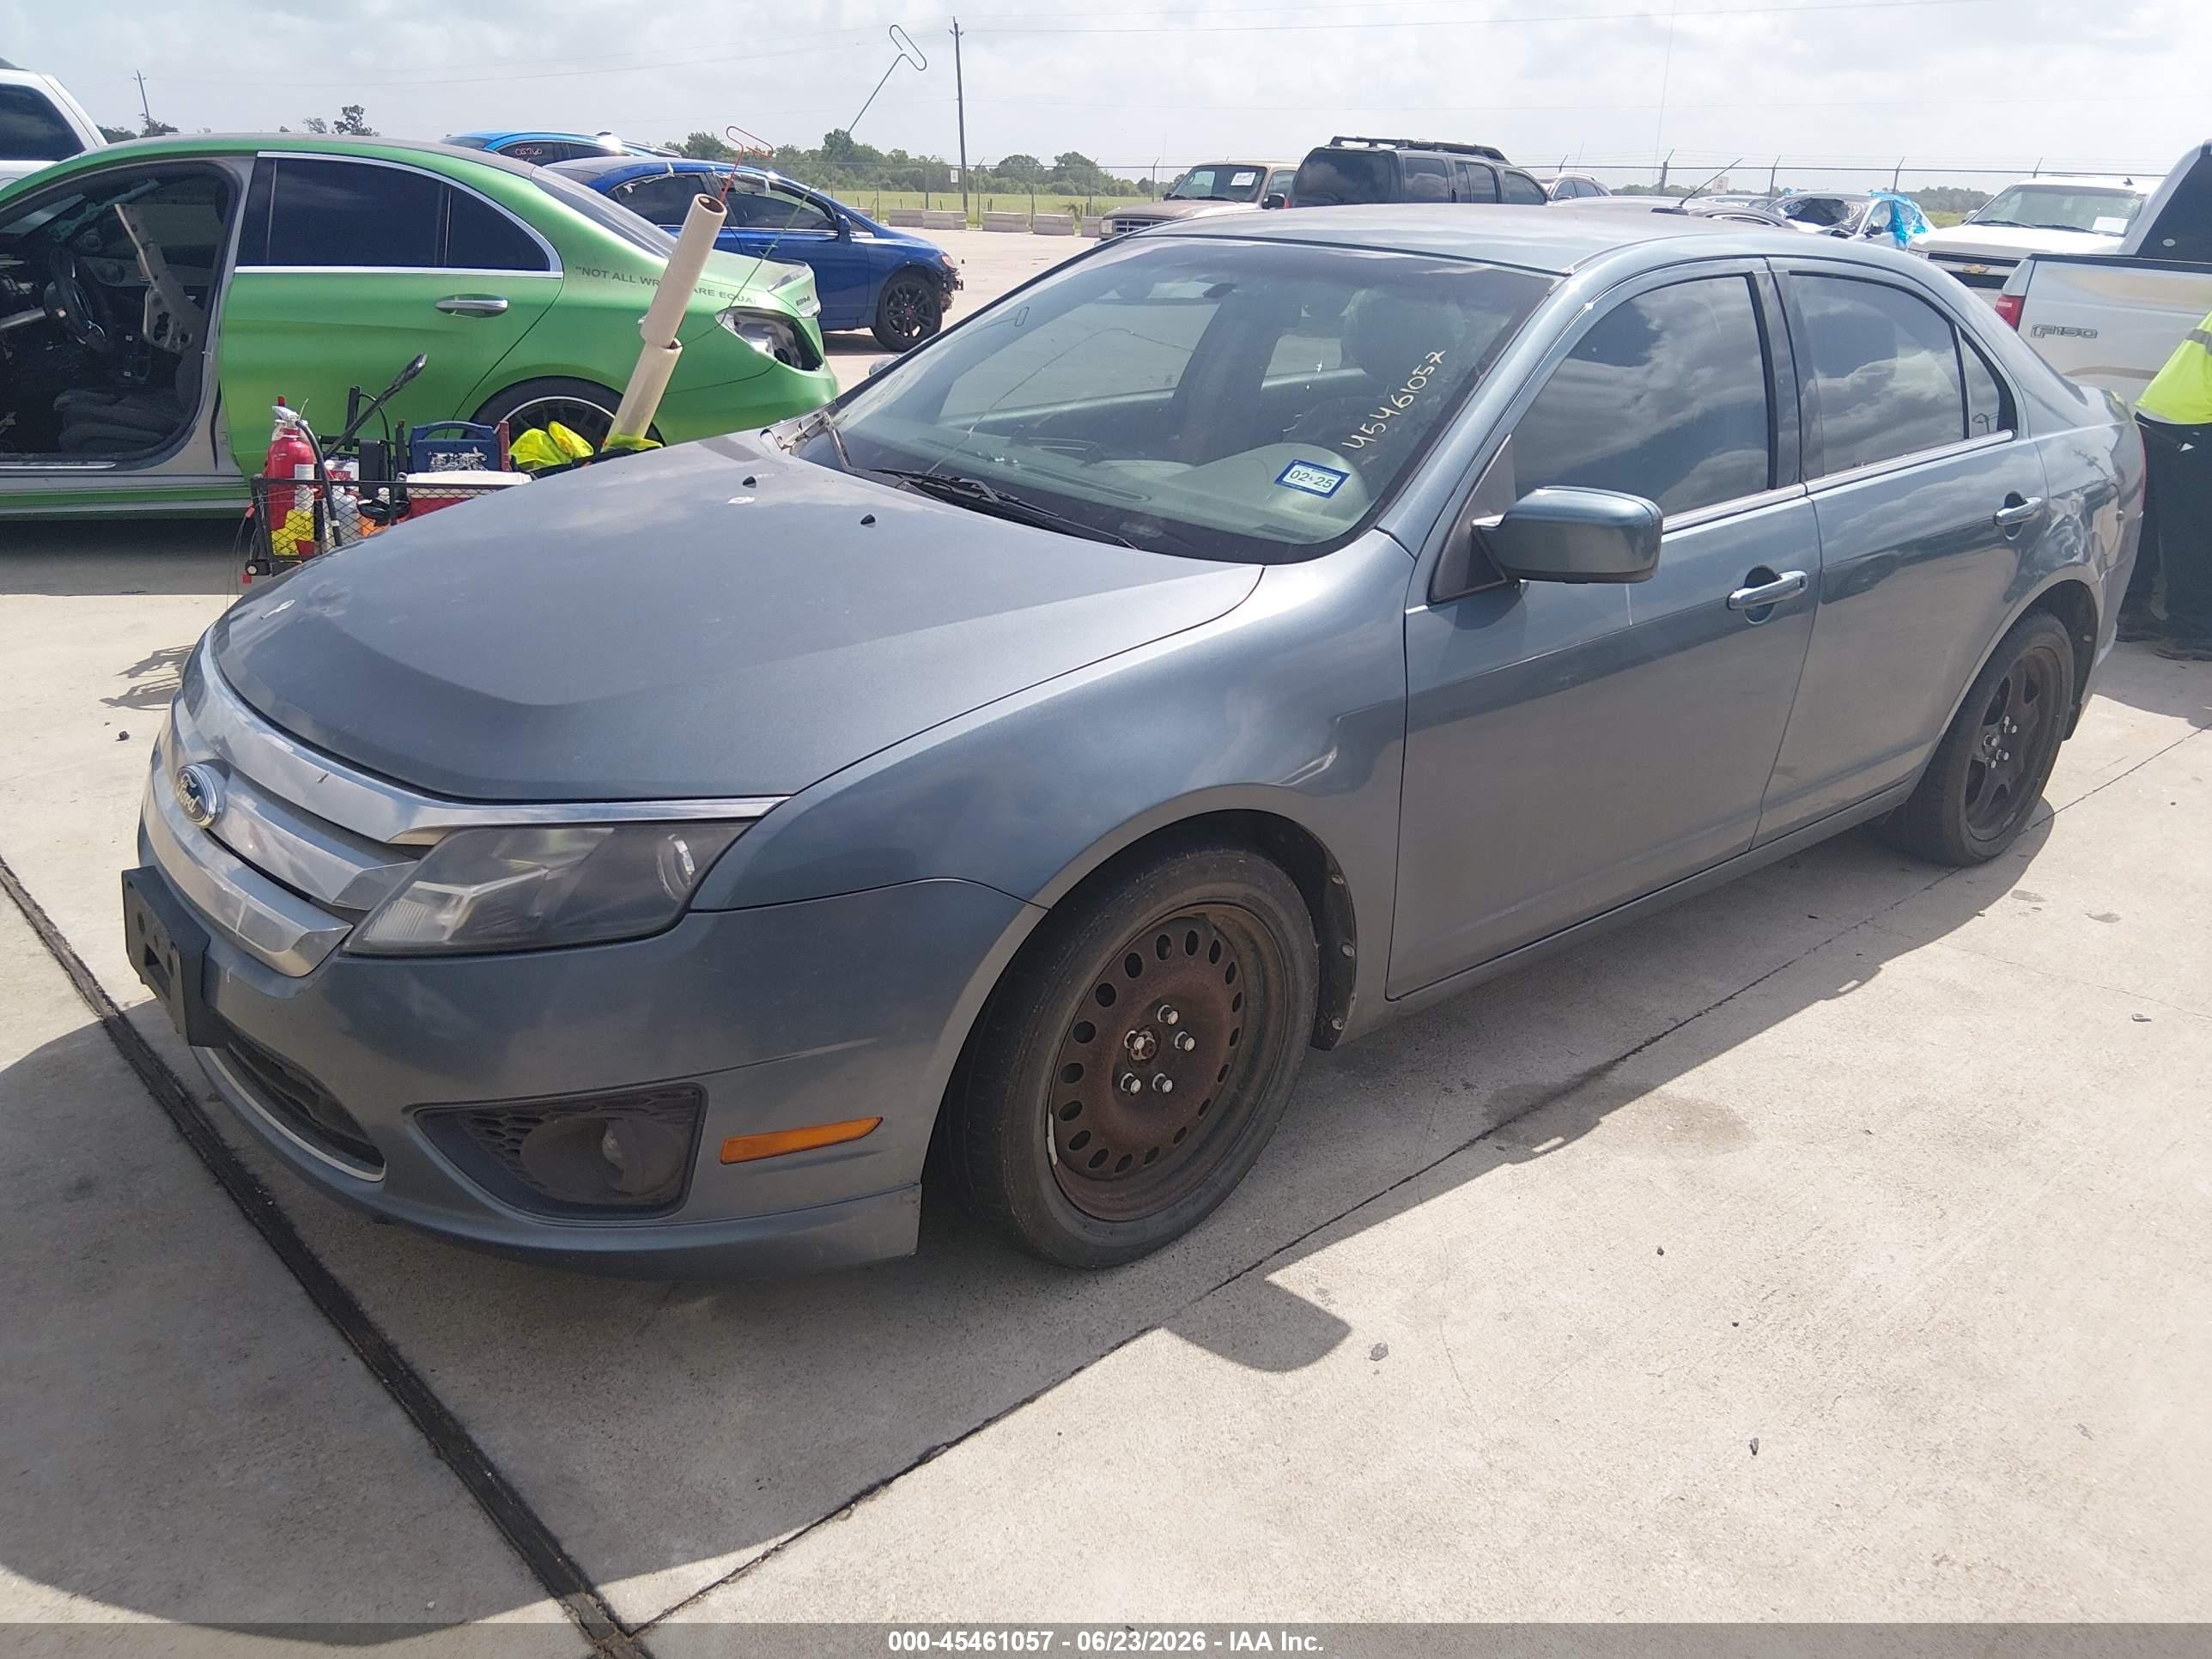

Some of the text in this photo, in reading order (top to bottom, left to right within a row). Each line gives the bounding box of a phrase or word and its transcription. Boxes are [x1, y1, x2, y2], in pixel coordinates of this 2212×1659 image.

[611, 272, 636, 283] ALL
[1290, 470, 1336, 489] 02 25
[175, 773, 201, 813] Ford
